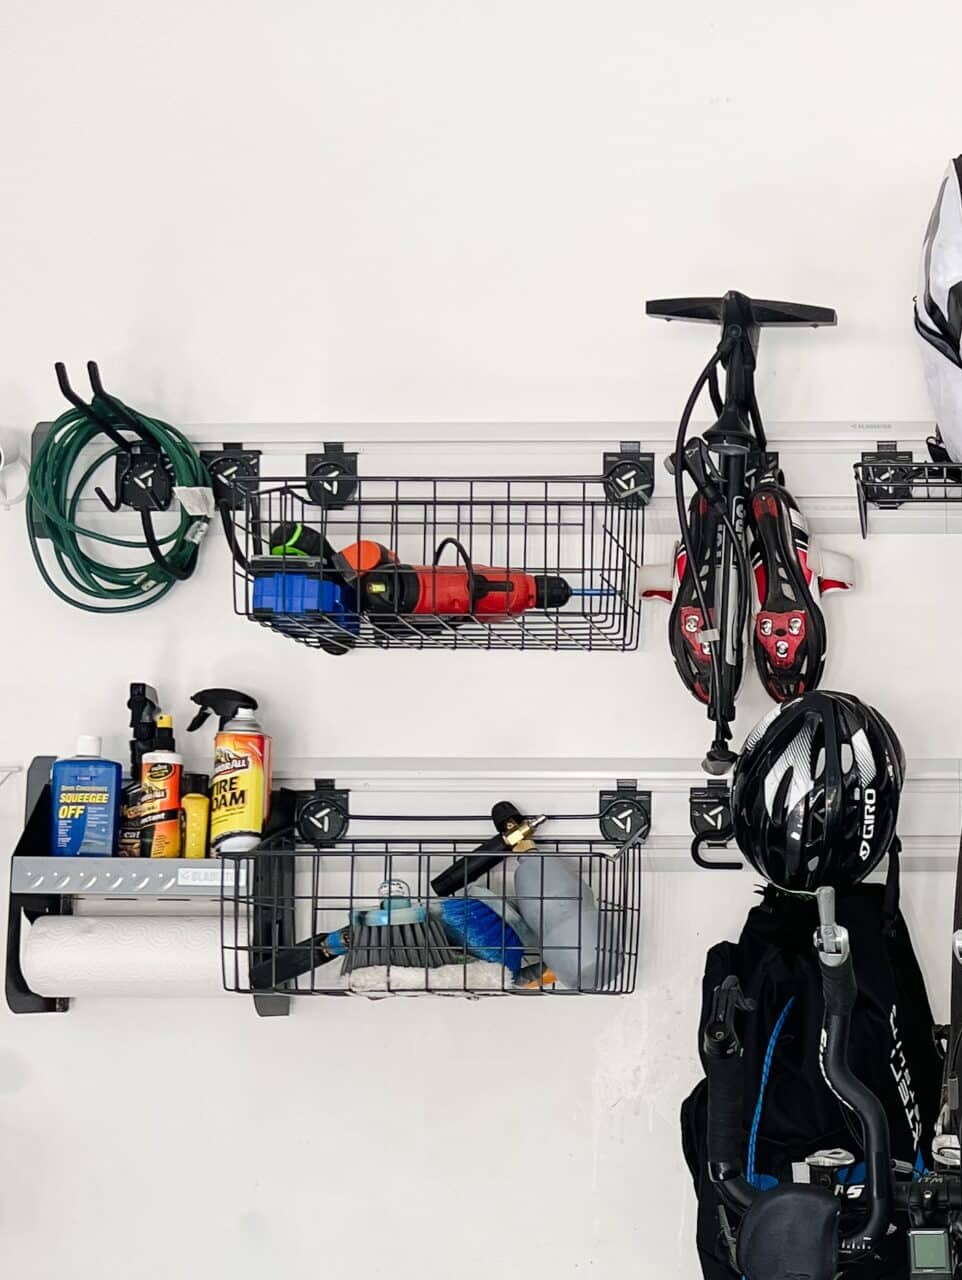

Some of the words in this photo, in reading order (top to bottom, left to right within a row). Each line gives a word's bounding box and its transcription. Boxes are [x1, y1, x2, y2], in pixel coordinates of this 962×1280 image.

[60, 793, 110, 804] SQUEEGEE
[58, 805, 86, 819] OFF
[863, 788, 876, 839] GIRO
